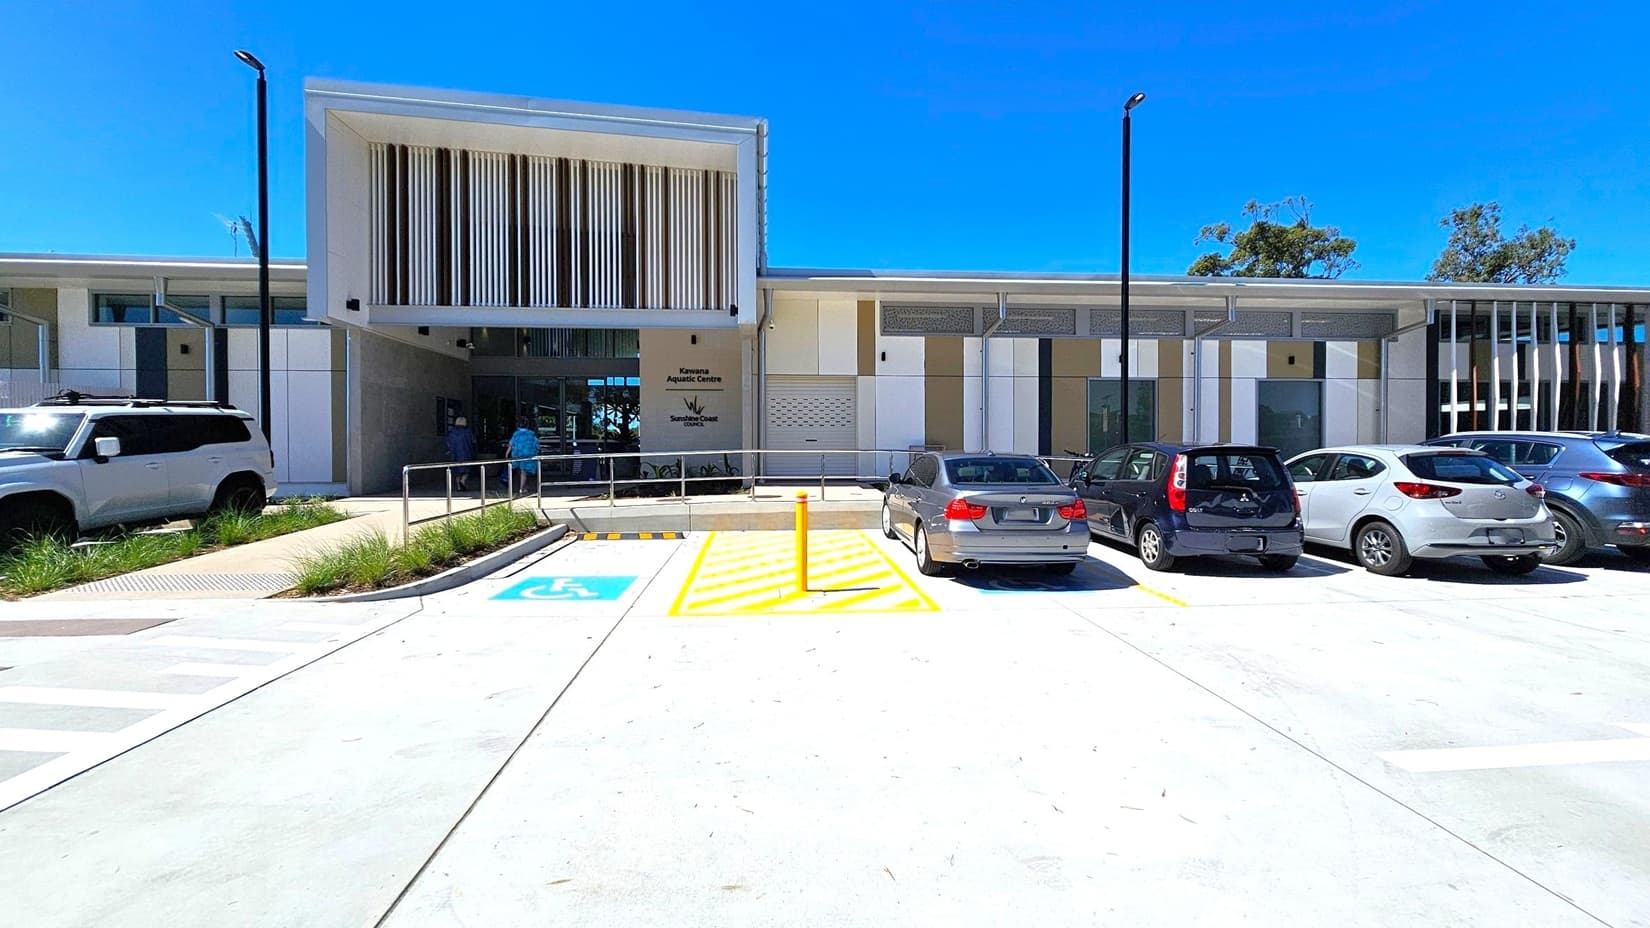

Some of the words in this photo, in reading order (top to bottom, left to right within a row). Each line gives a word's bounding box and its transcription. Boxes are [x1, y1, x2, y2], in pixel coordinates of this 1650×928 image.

[679, 367, 710, 375] Kawana
[666, 375, 696, 384] Aquatic
[697, 375, 722, 383] Centre
